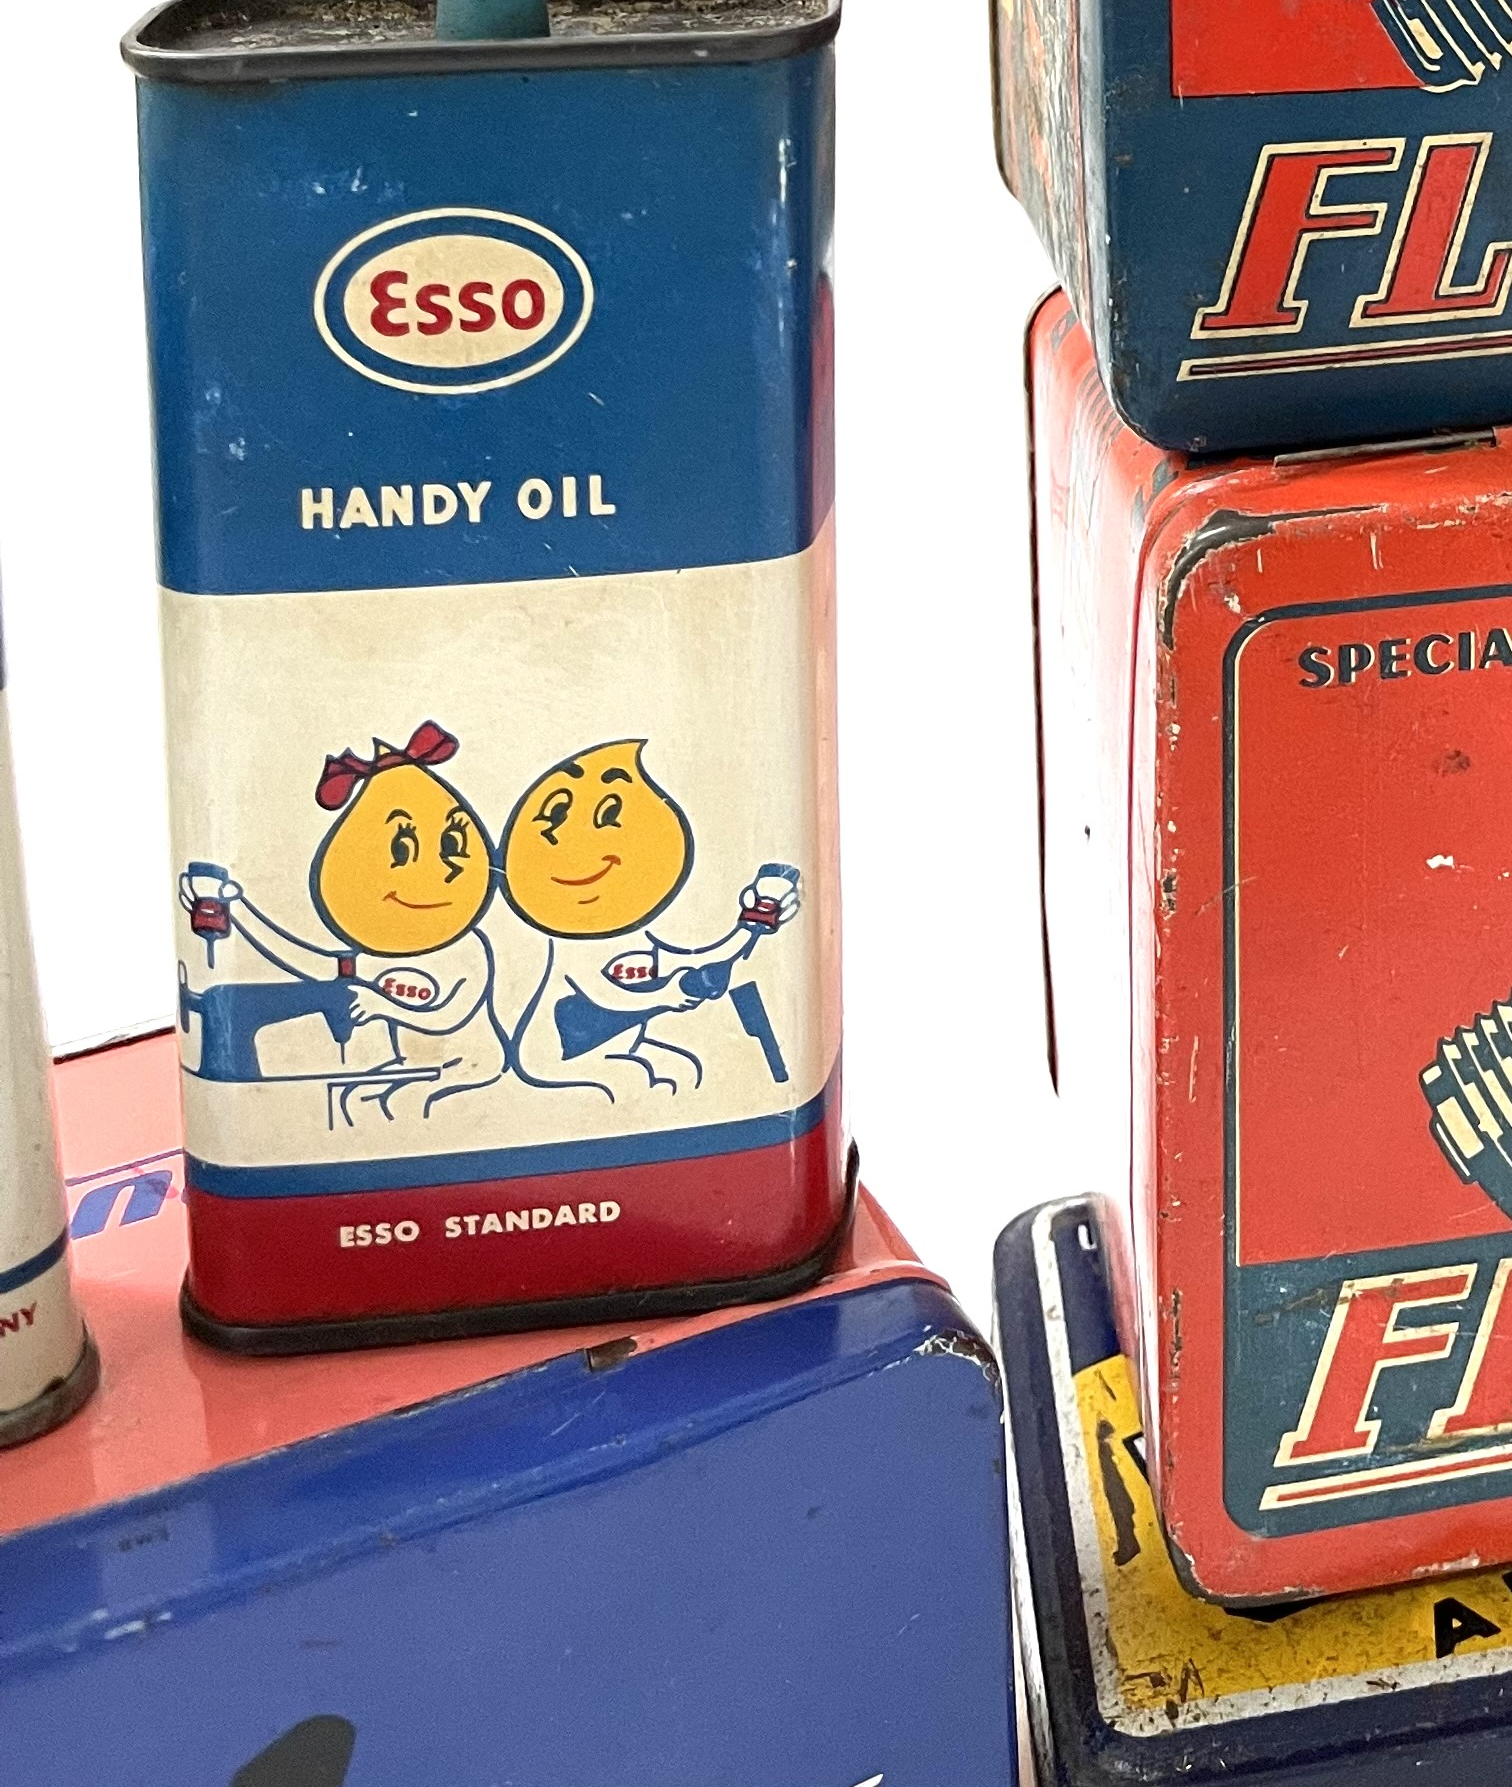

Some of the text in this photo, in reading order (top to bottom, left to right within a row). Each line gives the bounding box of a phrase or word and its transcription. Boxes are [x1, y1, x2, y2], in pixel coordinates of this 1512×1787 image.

[300, 473, 616, 530] HANDY OIL
[339, 1201, 621, 1248] ESSO STANDARD
